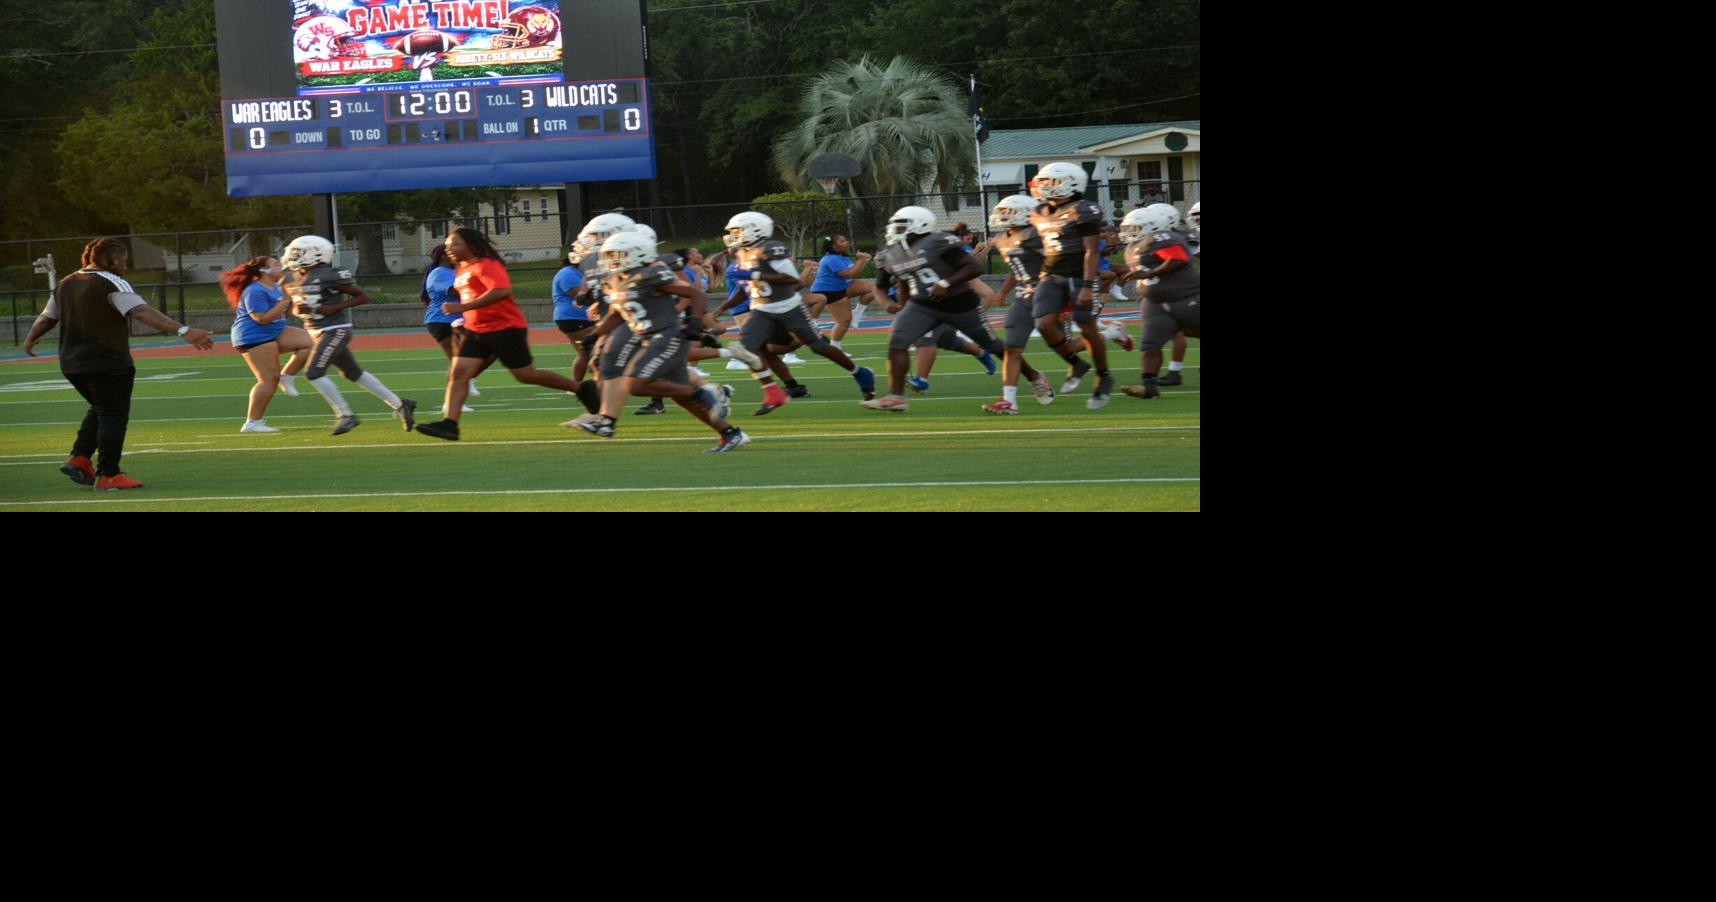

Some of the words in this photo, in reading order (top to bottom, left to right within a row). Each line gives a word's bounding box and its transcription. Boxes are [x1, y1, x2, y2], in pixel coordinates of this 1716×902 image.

[346, 3, 428, 39] GAME
[432, 0, 508, 29] TIME!
[308, 61, 340, 72] WAR
[342, 58, 393, 71] EAGLES
[411, 52, 437, 69] VS
[399, 91, 470, 116] 12:00
[486, 94, 515, 106] T.O.L.
[521, 90, 534, 108] 3
[231, 102, 260, 124] WAR
[261, 100, 311, 122] EAGLES
[329, 99, 342, 118] 3
[346, 102, 374, 114] T.O.L.
[533, 118, 539, 134] 1
[544, 119, 568, 131] QTR
[624, 108, 641, 130] 0
[350, 129, 364, 141] TO
[365, 128, 381, 140] GO
[484, 122, 505, 134] BALL
[506, 121, 518, 133] ON
[249, 127, 265, 149] 0
[295, 131, 323, 143] DOWN
[1088, 205, 1100, 215] 5
